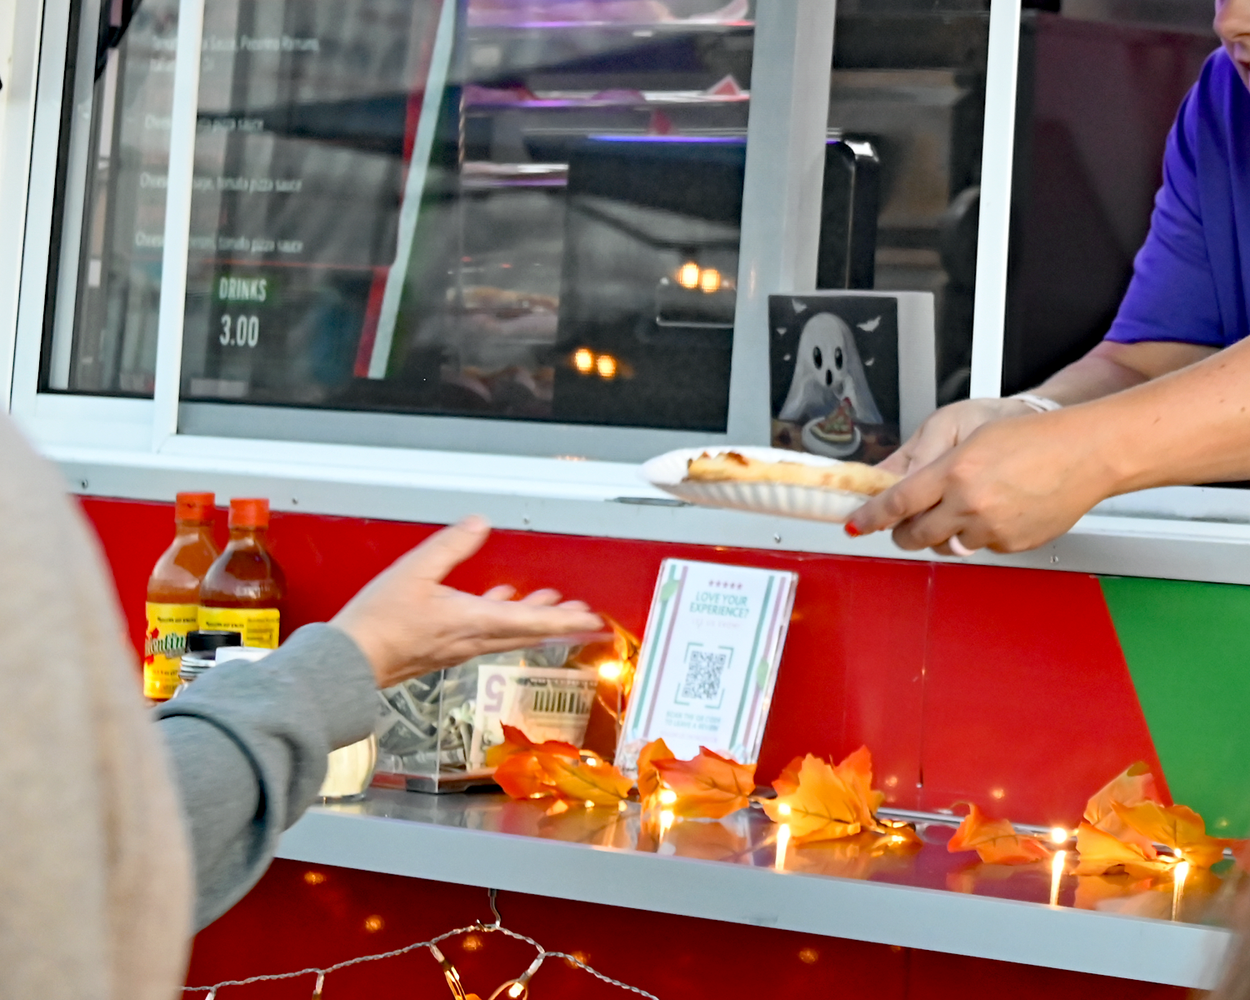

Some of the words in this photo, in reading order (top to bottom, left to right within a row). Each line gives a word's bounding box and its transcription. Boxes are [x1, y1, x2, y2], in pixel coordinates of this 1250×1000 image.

[219, 276, 267, 302] DRINKS
[219, 314, 259, 348] 3.00
[695, 591, 720, 604] LOVE
[722, 594, 748, 606] YOUR
